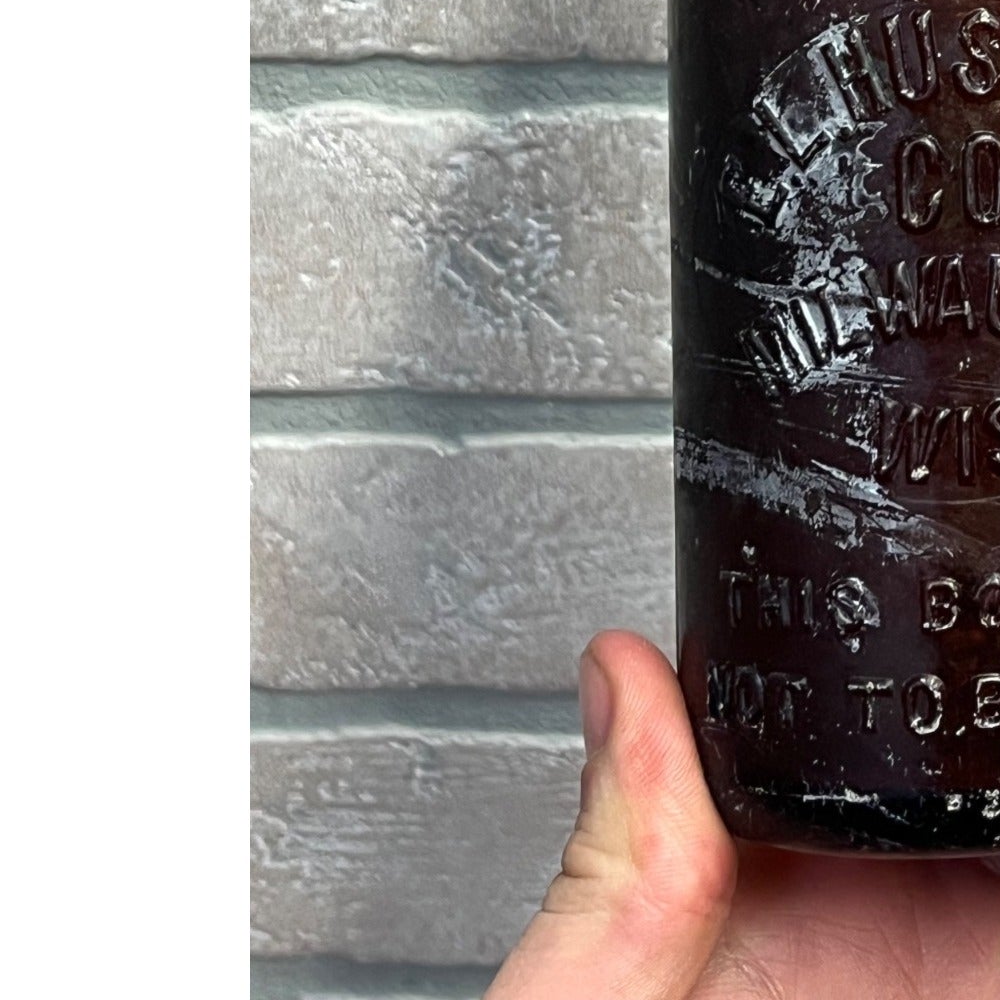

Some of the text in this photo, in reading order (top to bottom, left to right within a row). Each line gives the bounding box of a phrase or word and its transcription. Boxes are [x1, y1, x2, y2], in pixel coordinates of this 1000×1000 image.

[720, 570, 882, 634] THIS
[707, 661, 809, 727] NOT
[847, 674, 945, 735] TO
